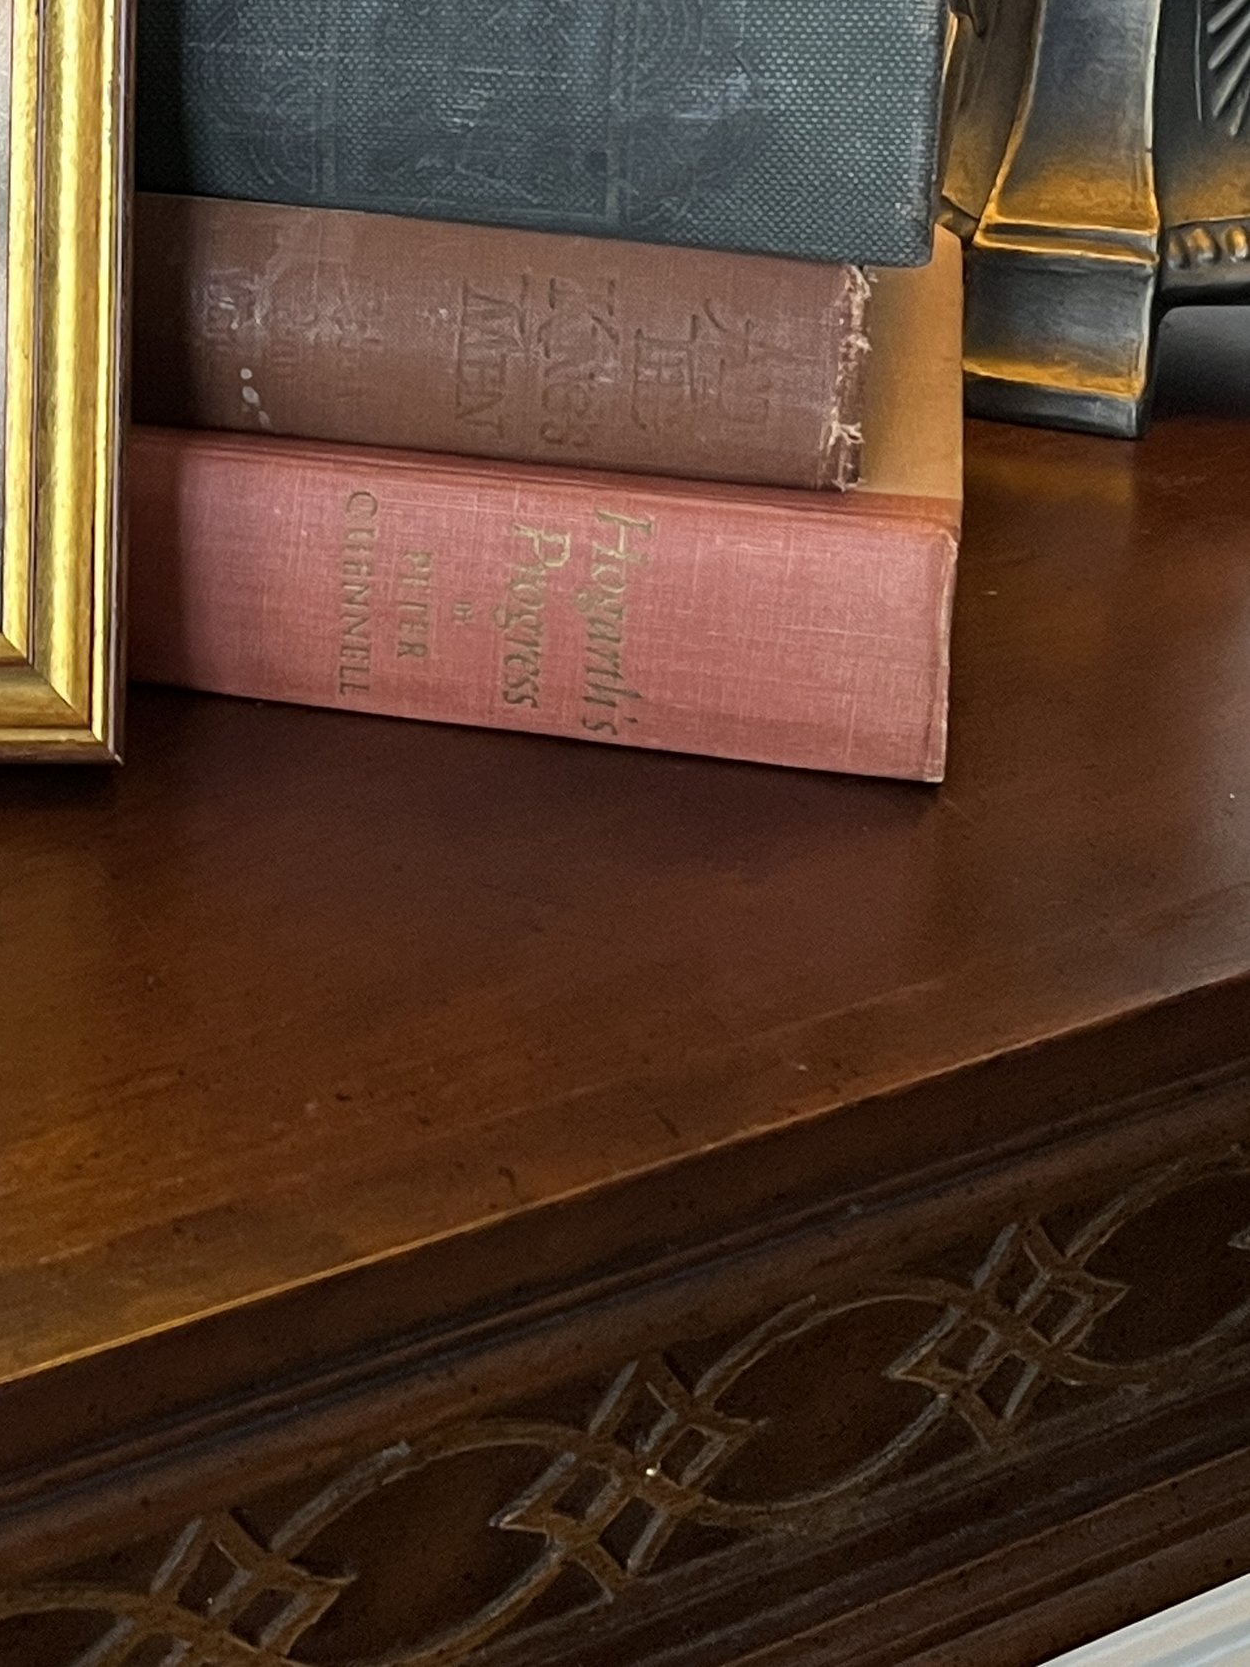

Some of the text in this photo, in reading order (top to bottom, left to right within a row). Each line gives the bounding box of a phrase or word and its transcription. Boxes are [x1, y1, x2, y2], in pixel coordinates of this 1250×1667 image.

[396, 550, 433, 659] PETER
[492, 522, 572, 709] Progress
[574, 509, 654, 736] Hogarth's
